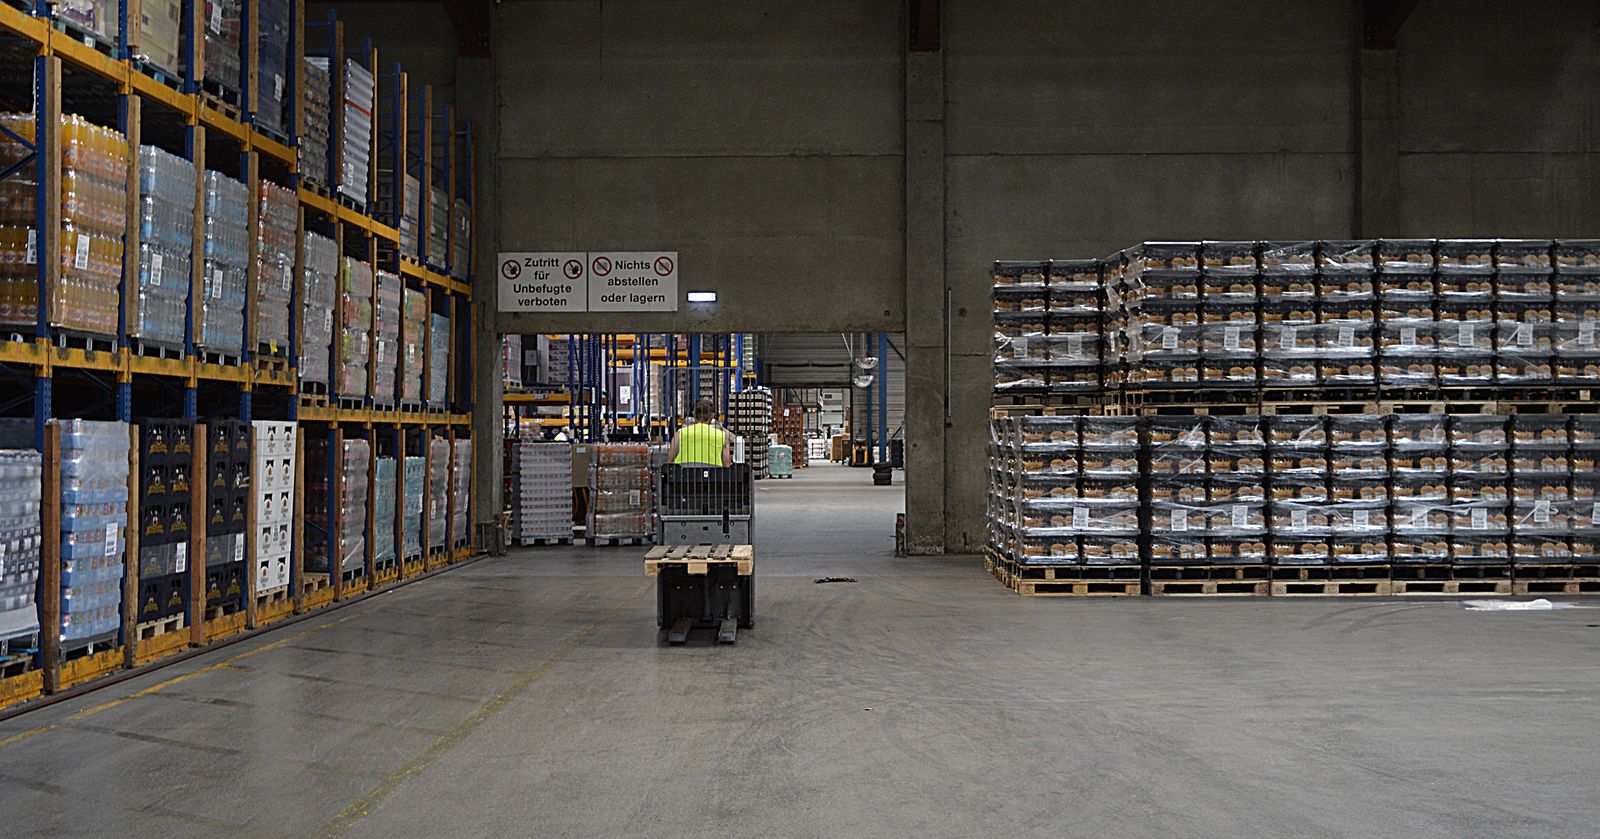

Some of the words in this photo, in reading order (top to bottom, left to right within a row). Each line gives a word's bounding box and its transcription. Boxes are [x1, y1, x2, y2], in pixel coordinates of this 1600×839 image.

[524, 257, 560, 267] Zutritt
[615, 260, 650, 270] Nichts
[534, 270, 550, 280] für
[608, 276, 658, 287] abstellen
[513, 283, 572, 295] Unbefugte
[517, 296, 568, 306] verboten
[601, 293, 627, 302] oder
[630, 293, 665, 304] lagern
